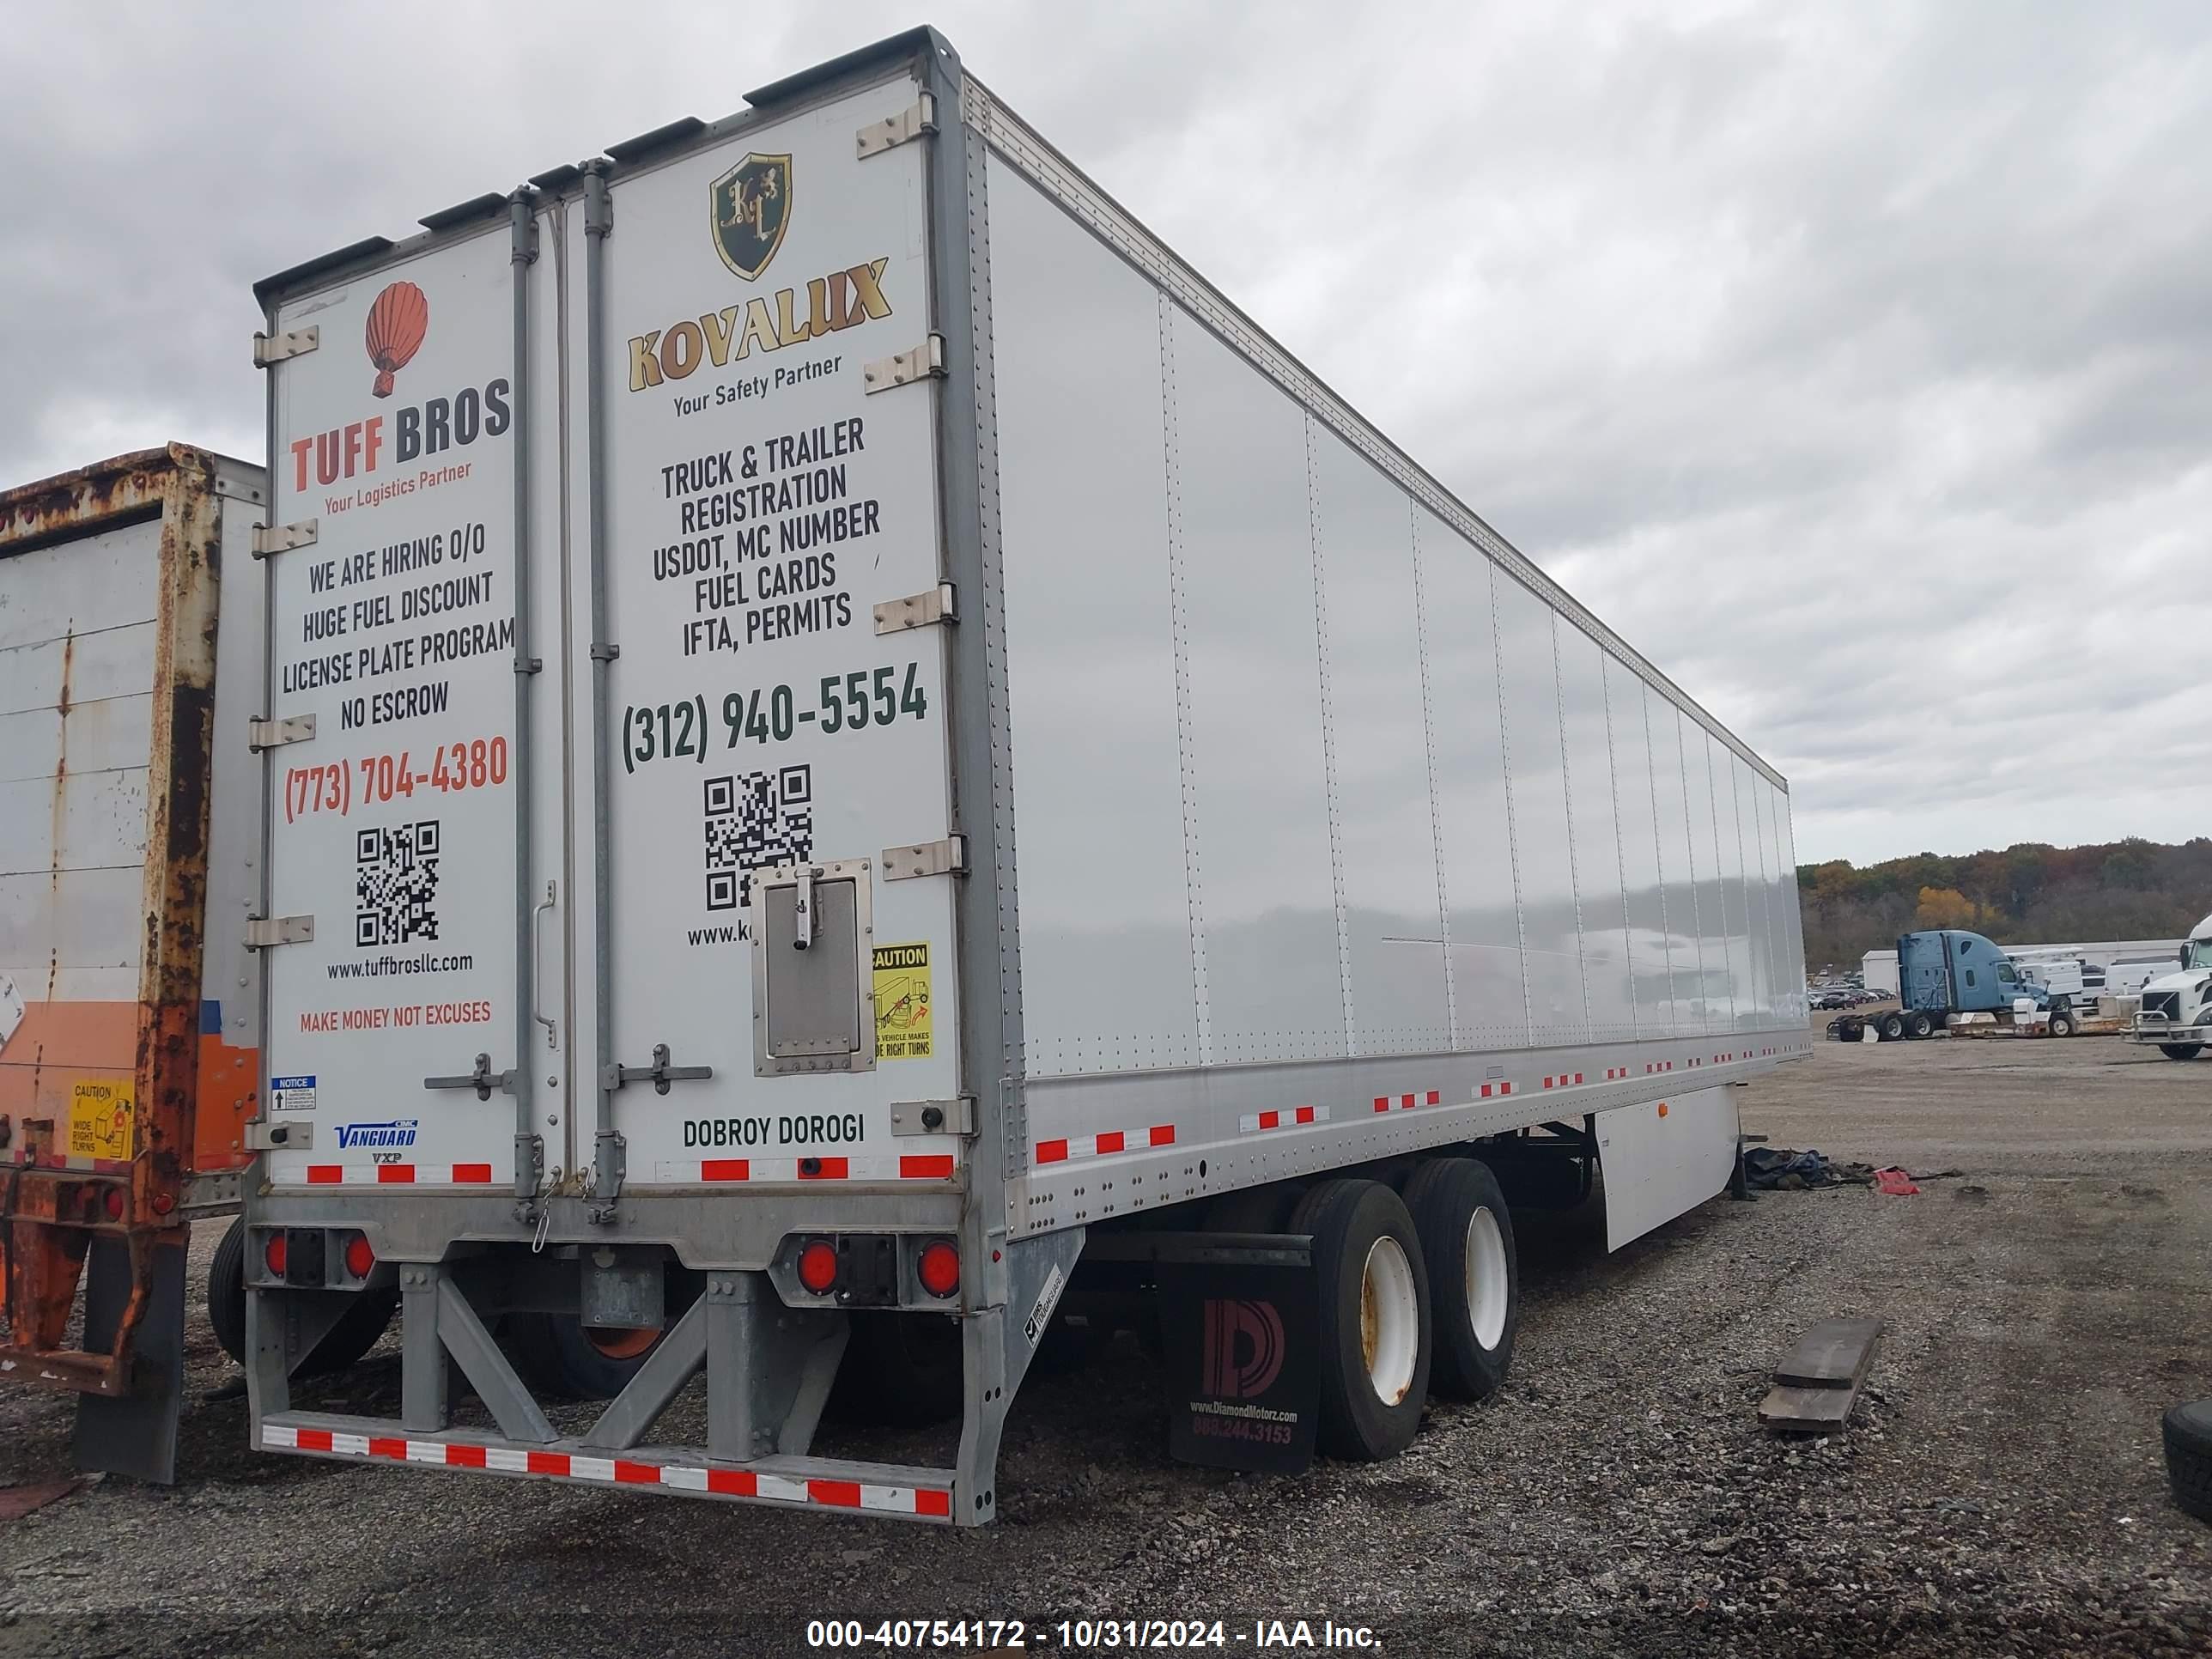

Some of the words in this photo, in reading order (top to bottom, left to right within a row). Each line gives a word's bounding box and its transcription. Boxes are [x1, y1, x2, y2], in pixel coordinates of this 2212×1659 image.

[628, 257, 892, 392] KOVALUX
[674, 392, 709, 417] Your
[716, 375, 768, 406] Safety
[775, 356, 842, 389] Partner
[290, 416, 383, 492] TUFF
[396, 378, 510, 464] BROS
[661, 450, 733, 498] TRUCK
[740, 444, 758, 478] &
[764, 416, 864, 473] TRAILER
[325, 494, 353, 516] Your
[356, 477, 415, 508] Logistics
[419, 462, 471, 489] Partner
[681, 463, 847, 534] REGISTRATION
[310, 561, 335, 594] WE
[341, 550, 376, 586] ARE
[382, 534, 442, 577] HIRING
[653, 534, 729, 580] USDOT,
[736, 524, 771, 562] MC
[780, 500, 880, 554] NUMBER
[304, 605, 346, 642] HUGE
[353, 595, 394, 631] FUEL
[402, 571, 493, 621] DISCOUNT
[696, 572, 749, 613] FUEL
[757, 552, 836, 599] CARDS
[684, 616, 738, 655] IFTA,
[746, 592, 852, 644] PERMITS
[283, 652, 352, 694] LICENSE
[359, 638, 414, 678] PLATE
[421, 617, 515, 665] PROGRAM
[342, 697, 364, 730] NO
[372, 681, 448, 724] ESCROW
[623, 693, 708, 775] (312)
[722, 661, 927, 749] 940-5554
[285, 759, 350, 824] (773)
[361, 736, 507, 804] 704-4380
[327, 953, 473, 979] www.tuffbrosllc.com
[301, 1012, 338, 1032] MAKE
[343, 1008, 389, 1030] MONEY
[394, 1006, 422, 1027] NOT
[426, 1001, 490, 1025] EXCUSES
[881, 1033, 906, 1042] VEHICLE
[908, 1032, 929, 1041] MAKES
[886, 1042, 905, 1056] RIGHT
[908, 1042, 930, 1054] TURNS
[75, 1085, 111, 1097] CAUTION
[279, 1078, 308, 1088] NOTICE
[71, 1142, 95, 1152] TURNS
[72, 1131, 94, 1142] RIGHT
[73, 1120, 91, 1131] WIDE
[334, 1124, 416, 1149] VANGUARD
[684, 1117, 771, 1147] DOBROY
[779, 1114, 864, 1145] DOROGI
[372, 1152, 402, 1164] VXP
[1190, 1401, 1297, 1423] www.DiamondMotorz.com
